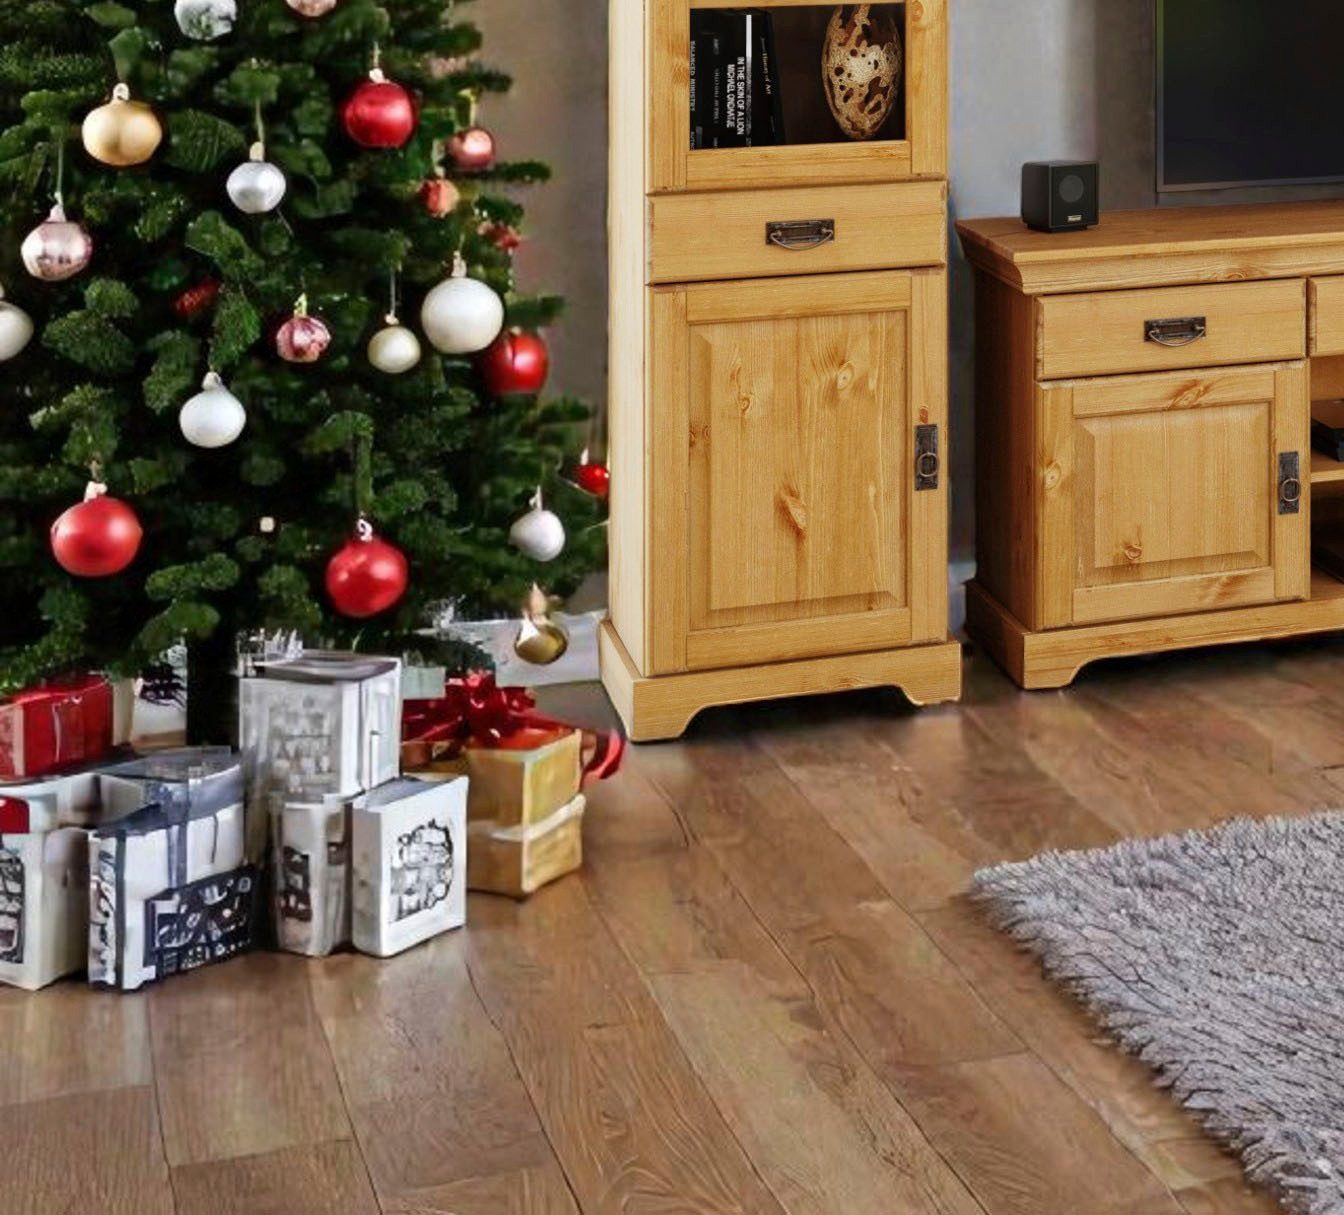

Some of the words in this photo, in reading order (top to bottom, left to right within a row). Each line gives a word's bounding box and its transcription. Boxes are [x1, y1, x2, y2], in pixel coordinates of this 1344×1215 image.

[737, 56, 744, 65] IN
[727, 64, 735, 93] MICHAEL
[727, 94, 735, 128] ONDAATJE
[737, 100, 744, 110] OF
